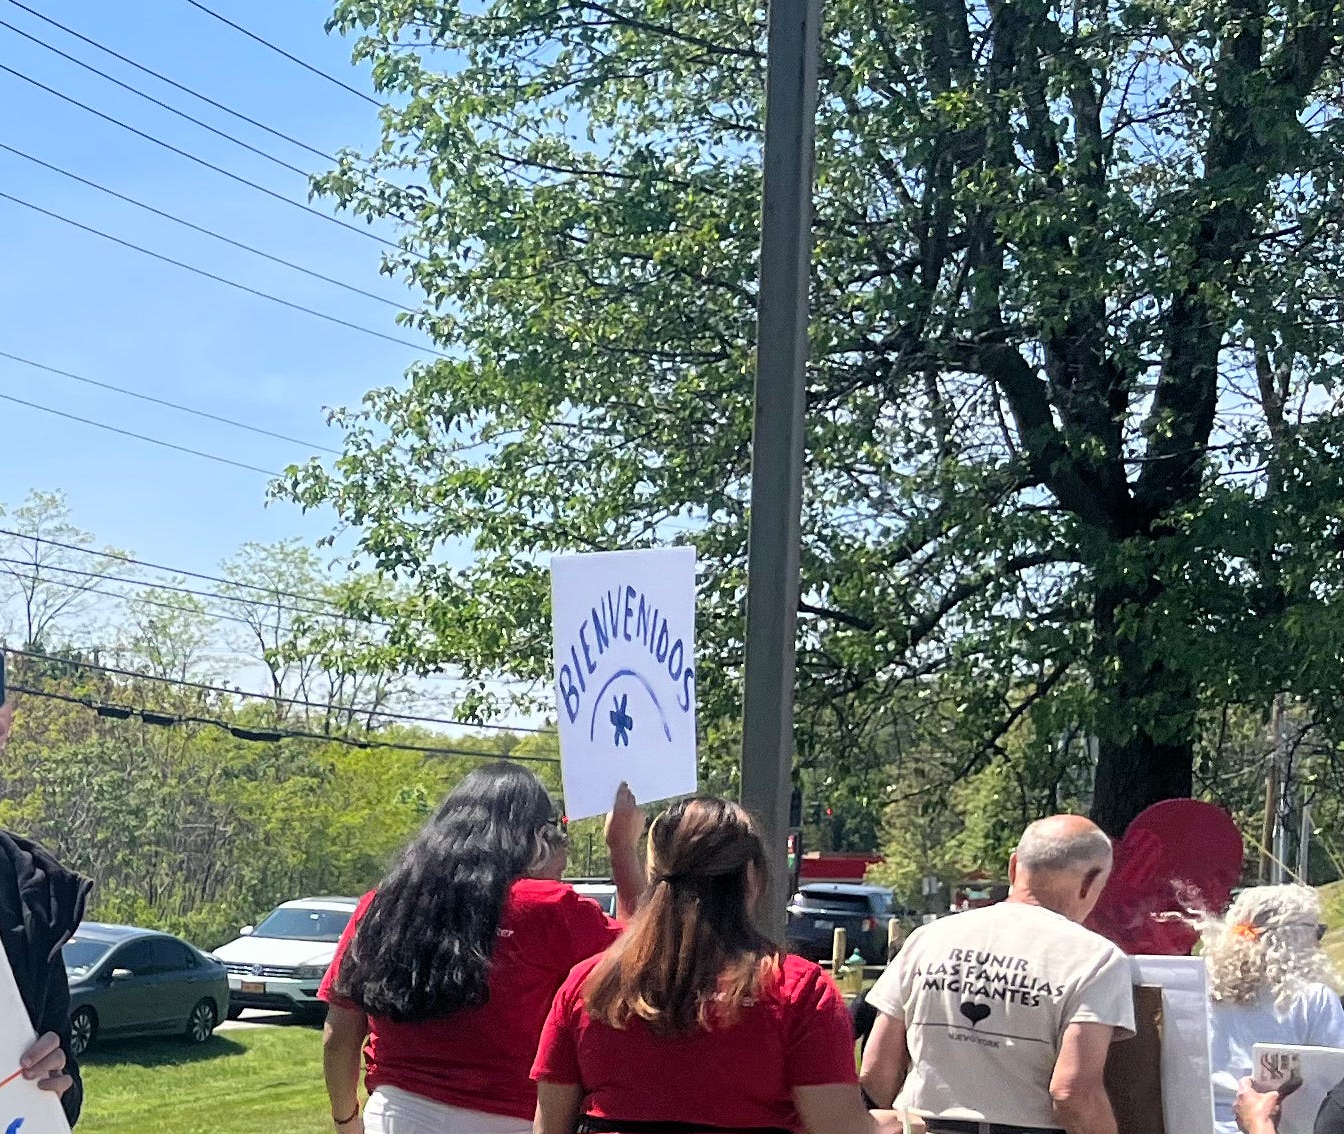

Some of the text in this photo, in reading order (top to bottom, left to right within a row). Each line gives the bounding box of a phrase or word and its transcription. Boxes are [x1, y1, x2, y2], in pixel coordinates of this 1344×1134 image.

[559, 585, 695, 724] BIENVENIDOS
[948, 948, 1029, 972] REUNIR
[922, 978, 1040, 1007] MIGRANTES
[926, 962, 961, 976] LAS
[966, 965, 1066, 997] FAMILIAS
